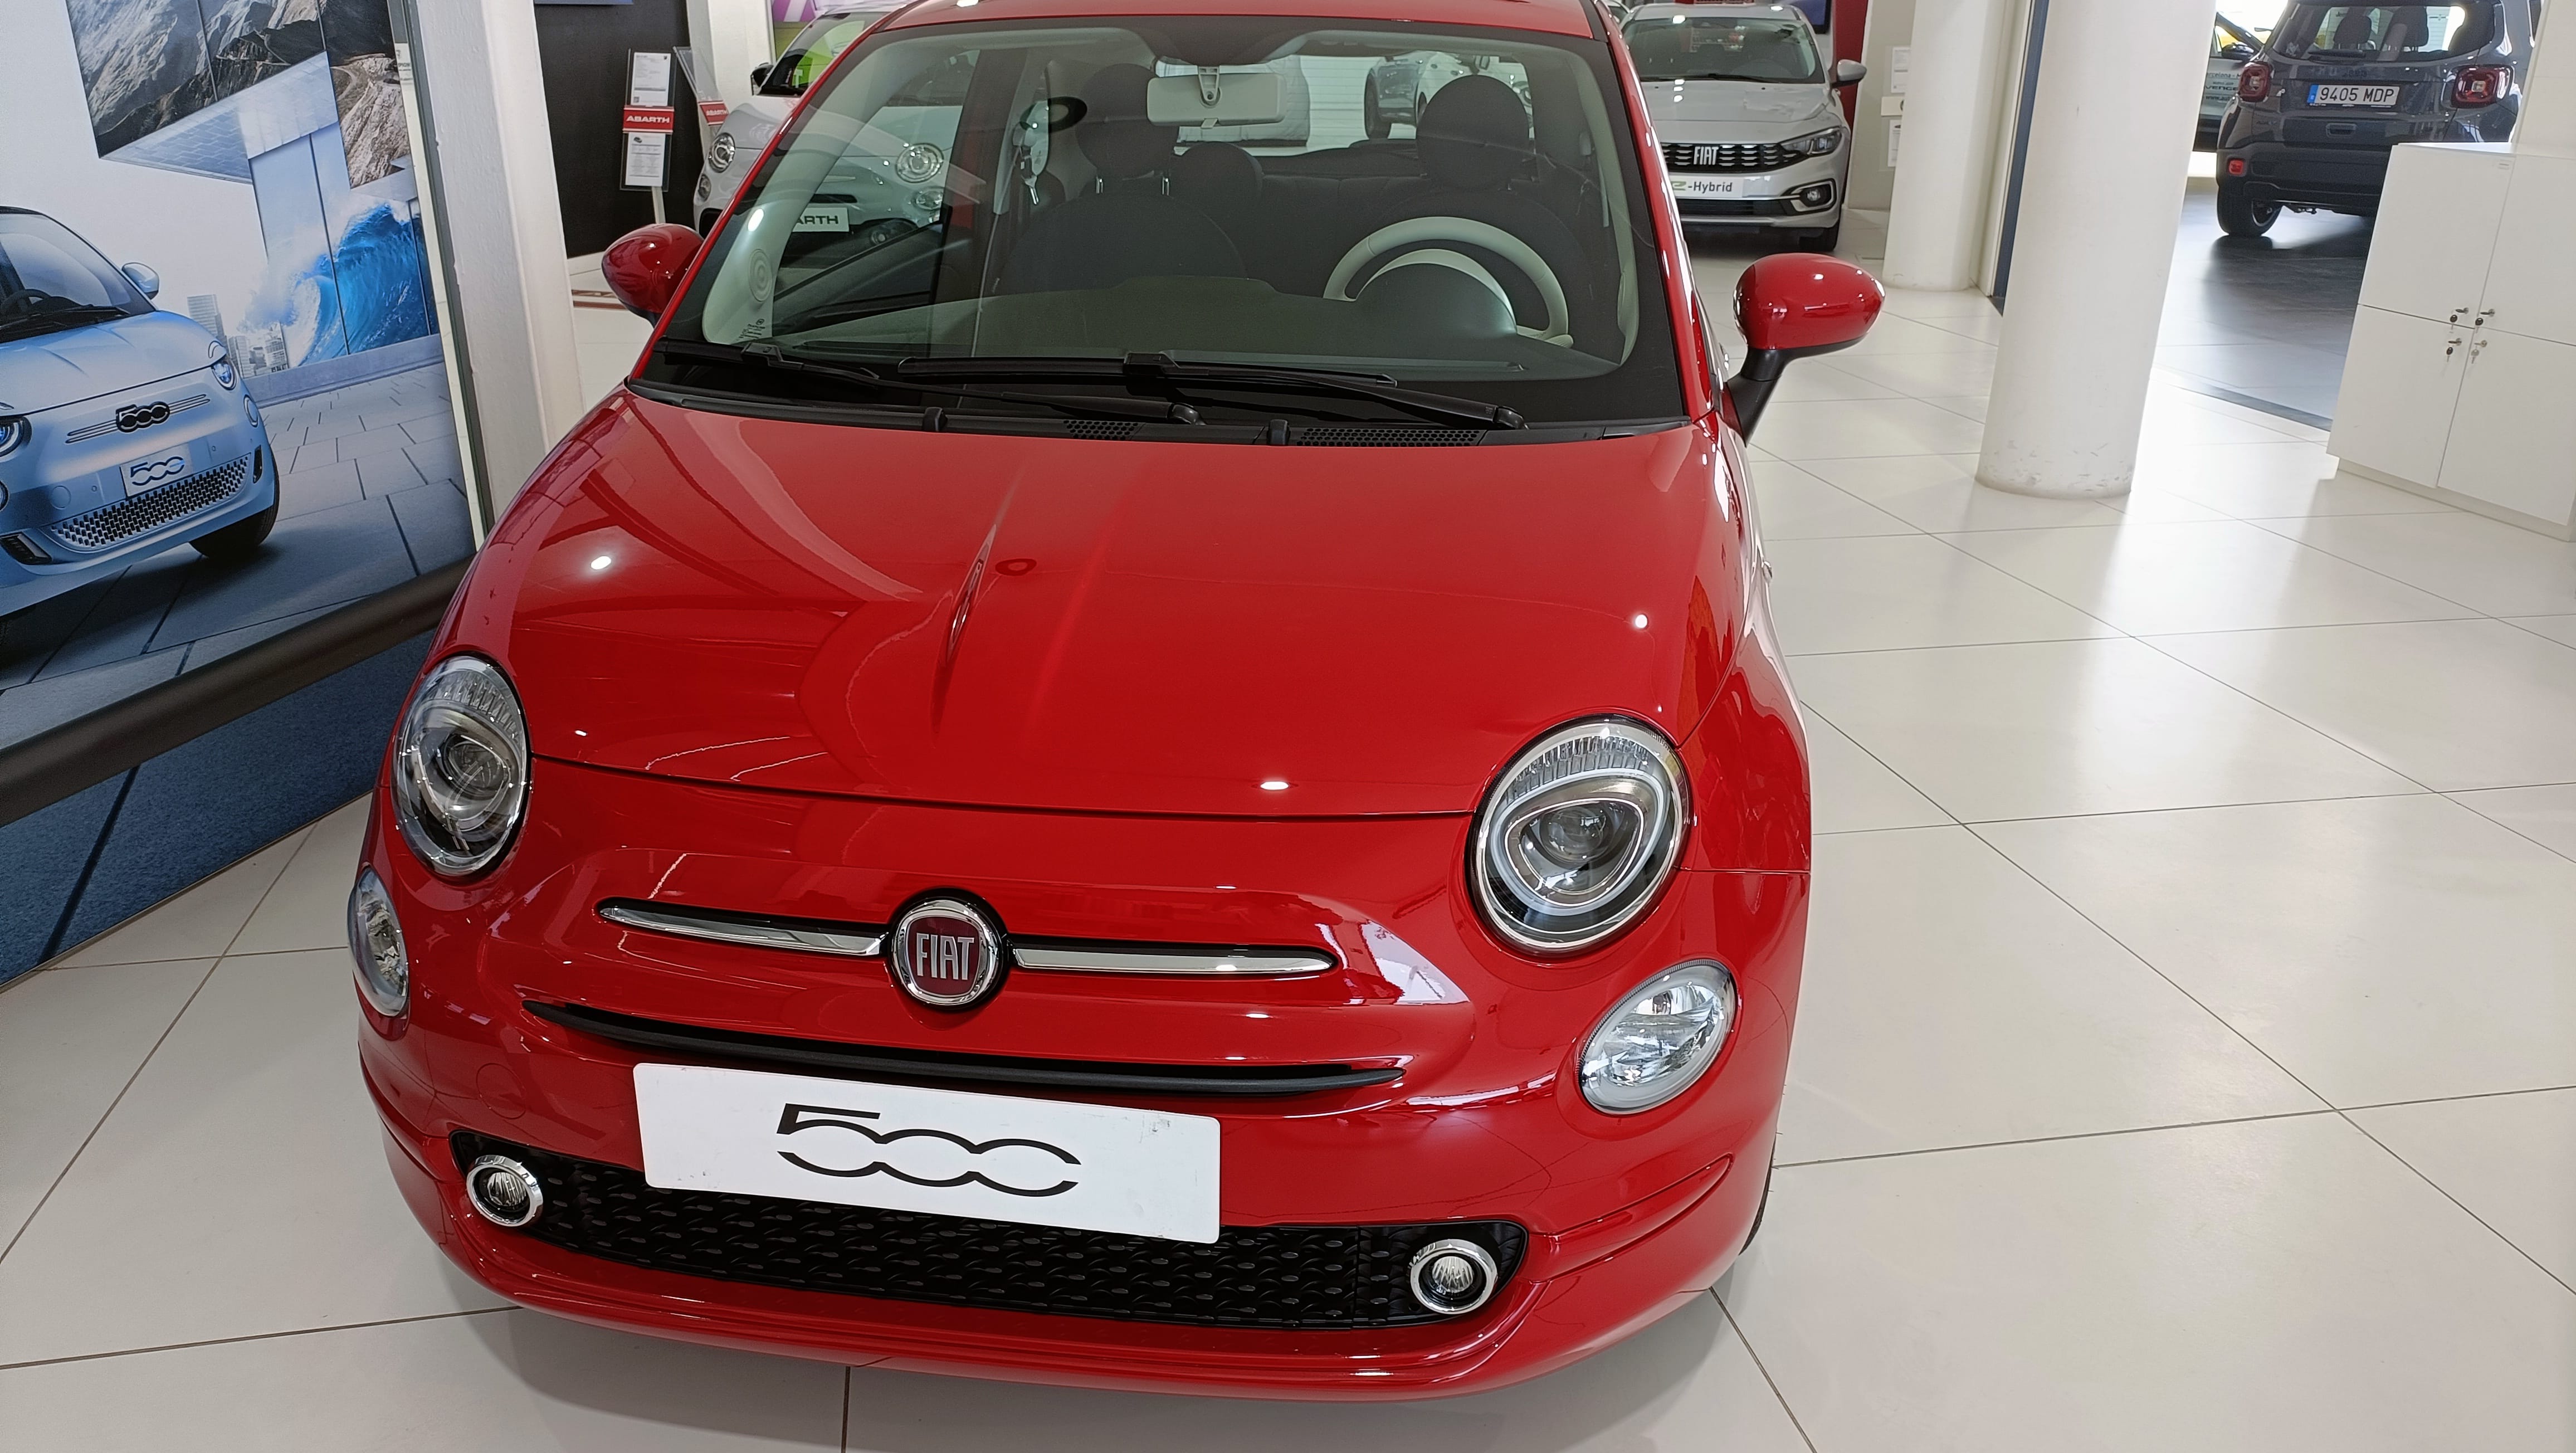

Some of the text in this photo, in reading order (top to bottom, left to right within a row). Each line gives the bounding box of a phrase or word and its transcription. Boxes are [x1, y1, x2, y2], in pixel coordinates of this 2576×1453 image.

[2320, 87, 2359, 101] 9405
[2363, 88, 2394, 103] MDP
[626, 115, 670, 123] ABARTH
[1693, 146, 1719, 165] FIAT
[797, 216, 839, 225] ARTH
[118, 404, 169, 430] 500
[130, 456, 186, 486] 500
[915, 933, 974, 981] FIAT
[776, 1103, 1082, 1198] 500
